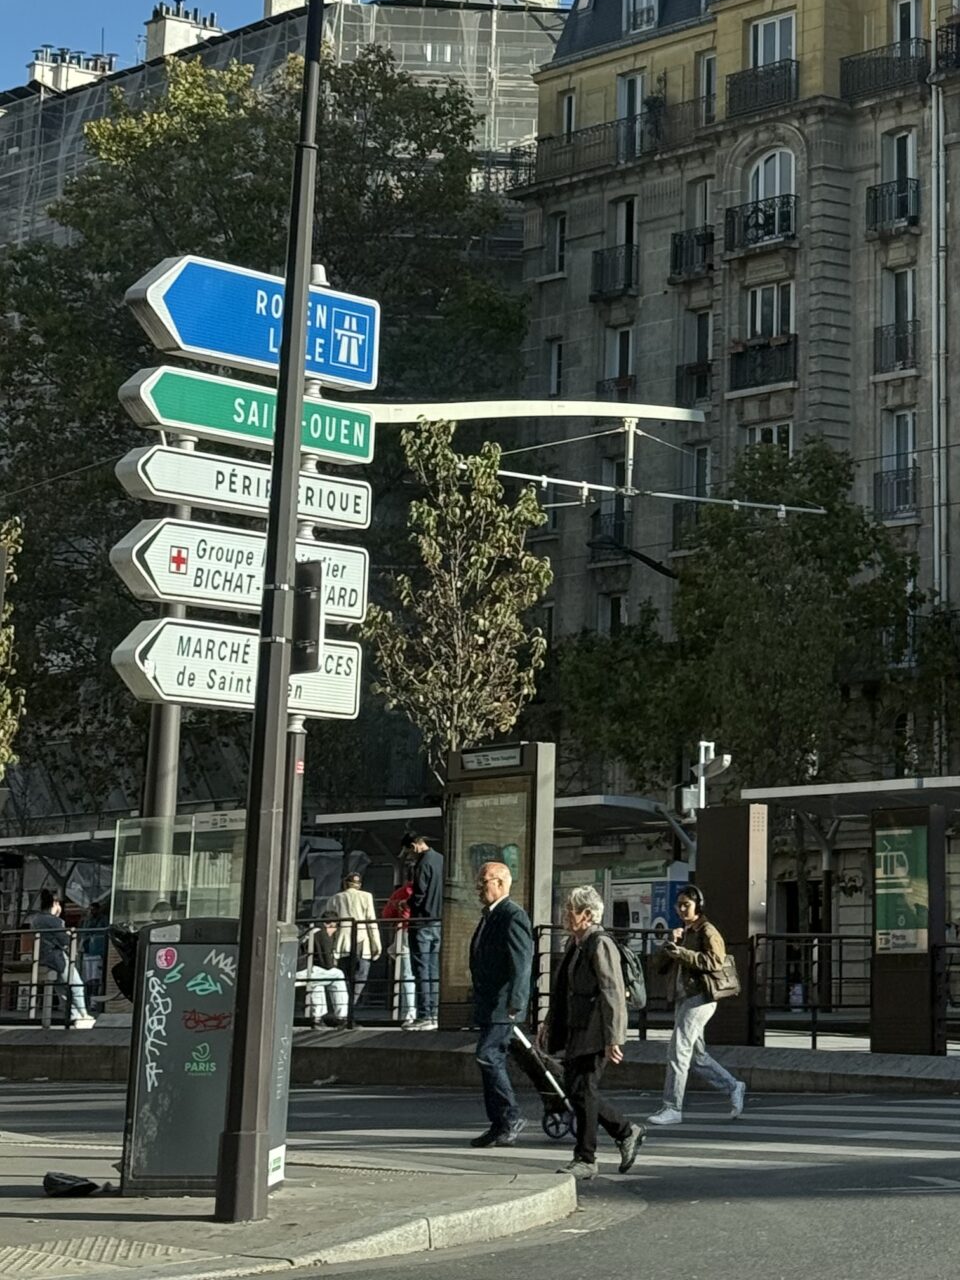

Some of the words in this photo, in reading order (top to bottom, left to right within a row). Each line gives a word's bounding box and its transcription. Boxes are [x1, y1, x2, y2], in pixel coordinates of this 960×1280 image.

[256, 289, 327, 330] ROEN
[233, 397, 365, 449] SAI-OUEN
[215, 468, 362, 515] PÉRIPRIQUE
[196, 538, 255, 567] Groupe
[177, 635, 251, 665] MARCHÉ
[323, 654, 354, 678] CES
[177, 665, 196, 688] de
[206, 668, 302, 700] Sainten
[184, 1061, 217, 1073] PARIS
